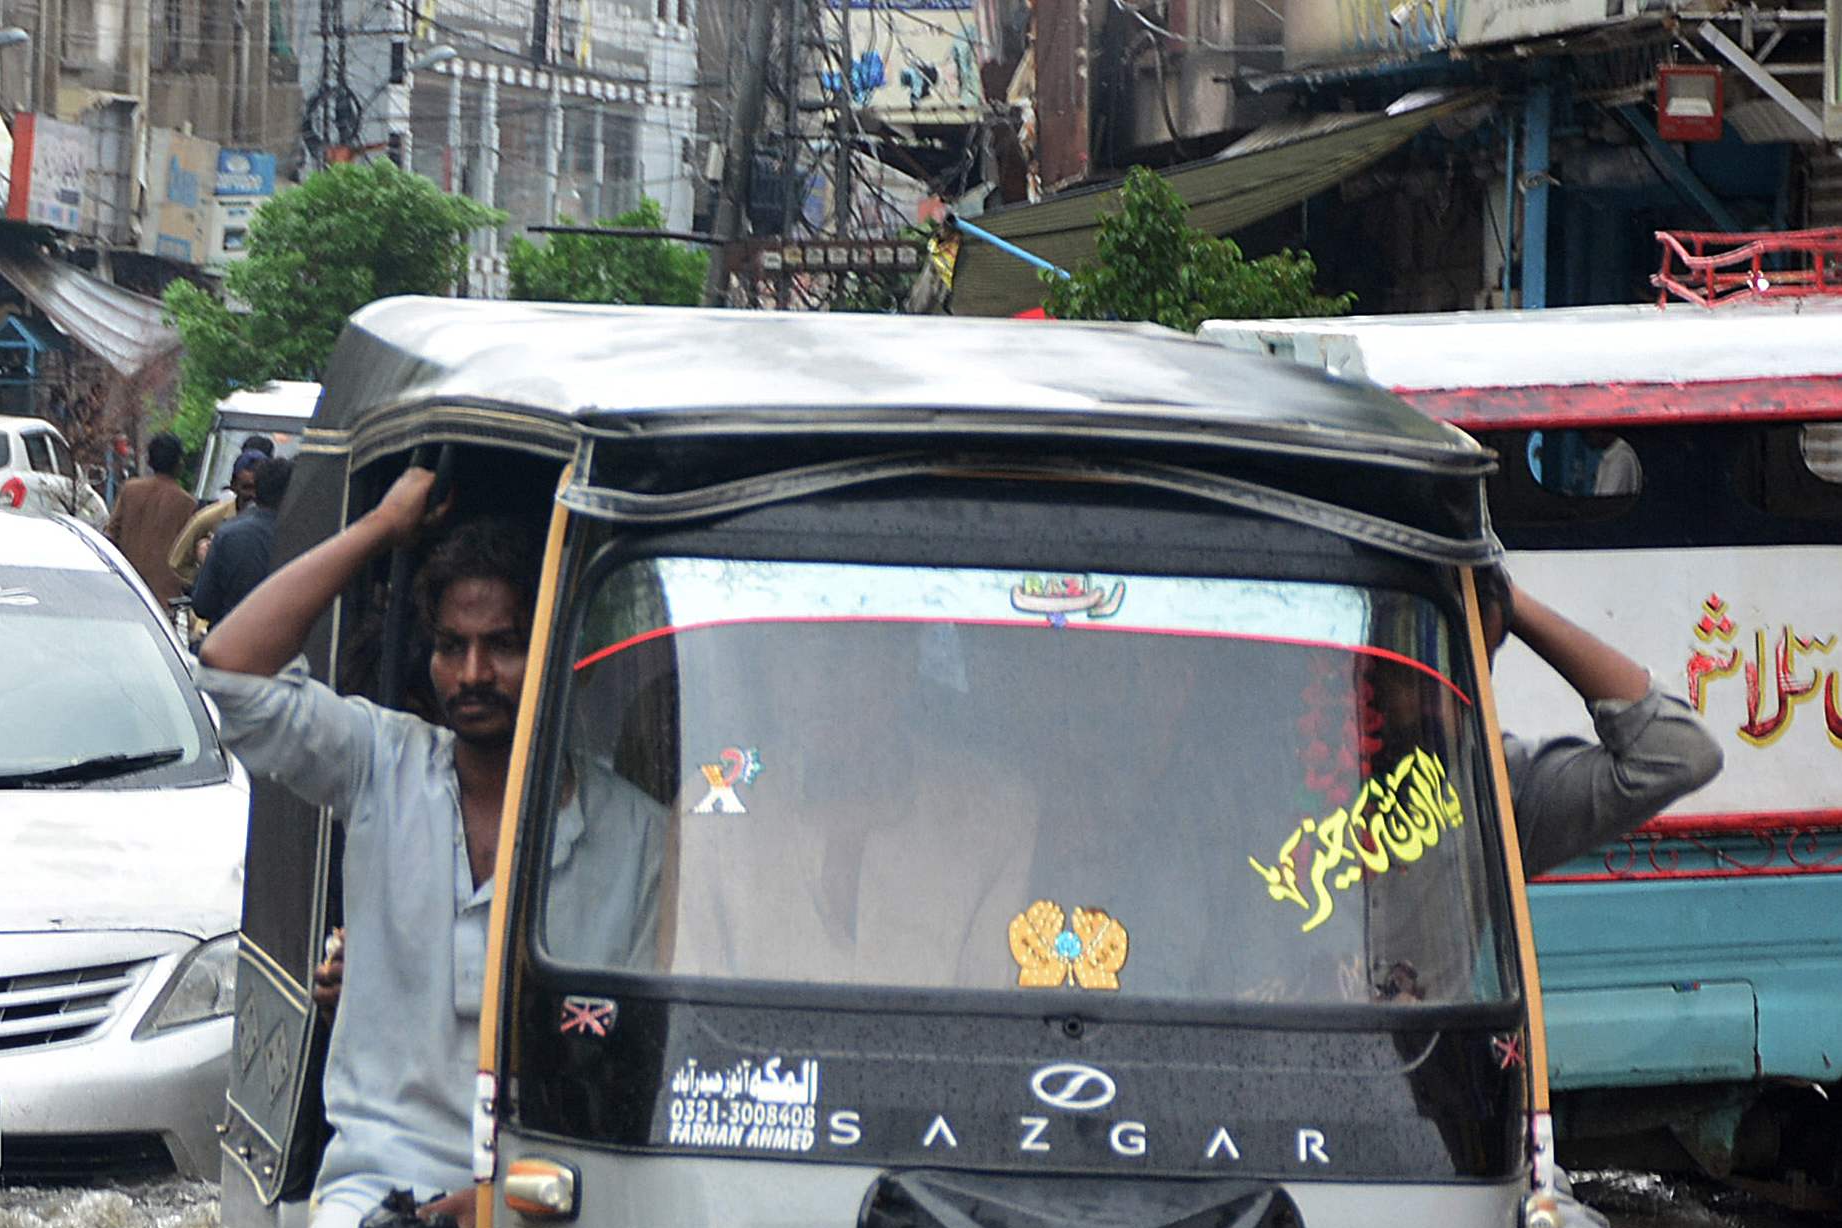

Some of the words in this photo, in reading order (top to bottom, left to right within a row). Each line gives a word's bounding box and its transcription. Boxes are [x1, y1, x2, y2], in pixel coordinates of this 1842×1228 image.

[670, 1098, 817, 1130] 0321-3008408
[669, 1122, 746, 1148] FARHAN
[746, 1126, 815, 1152] AHMED
